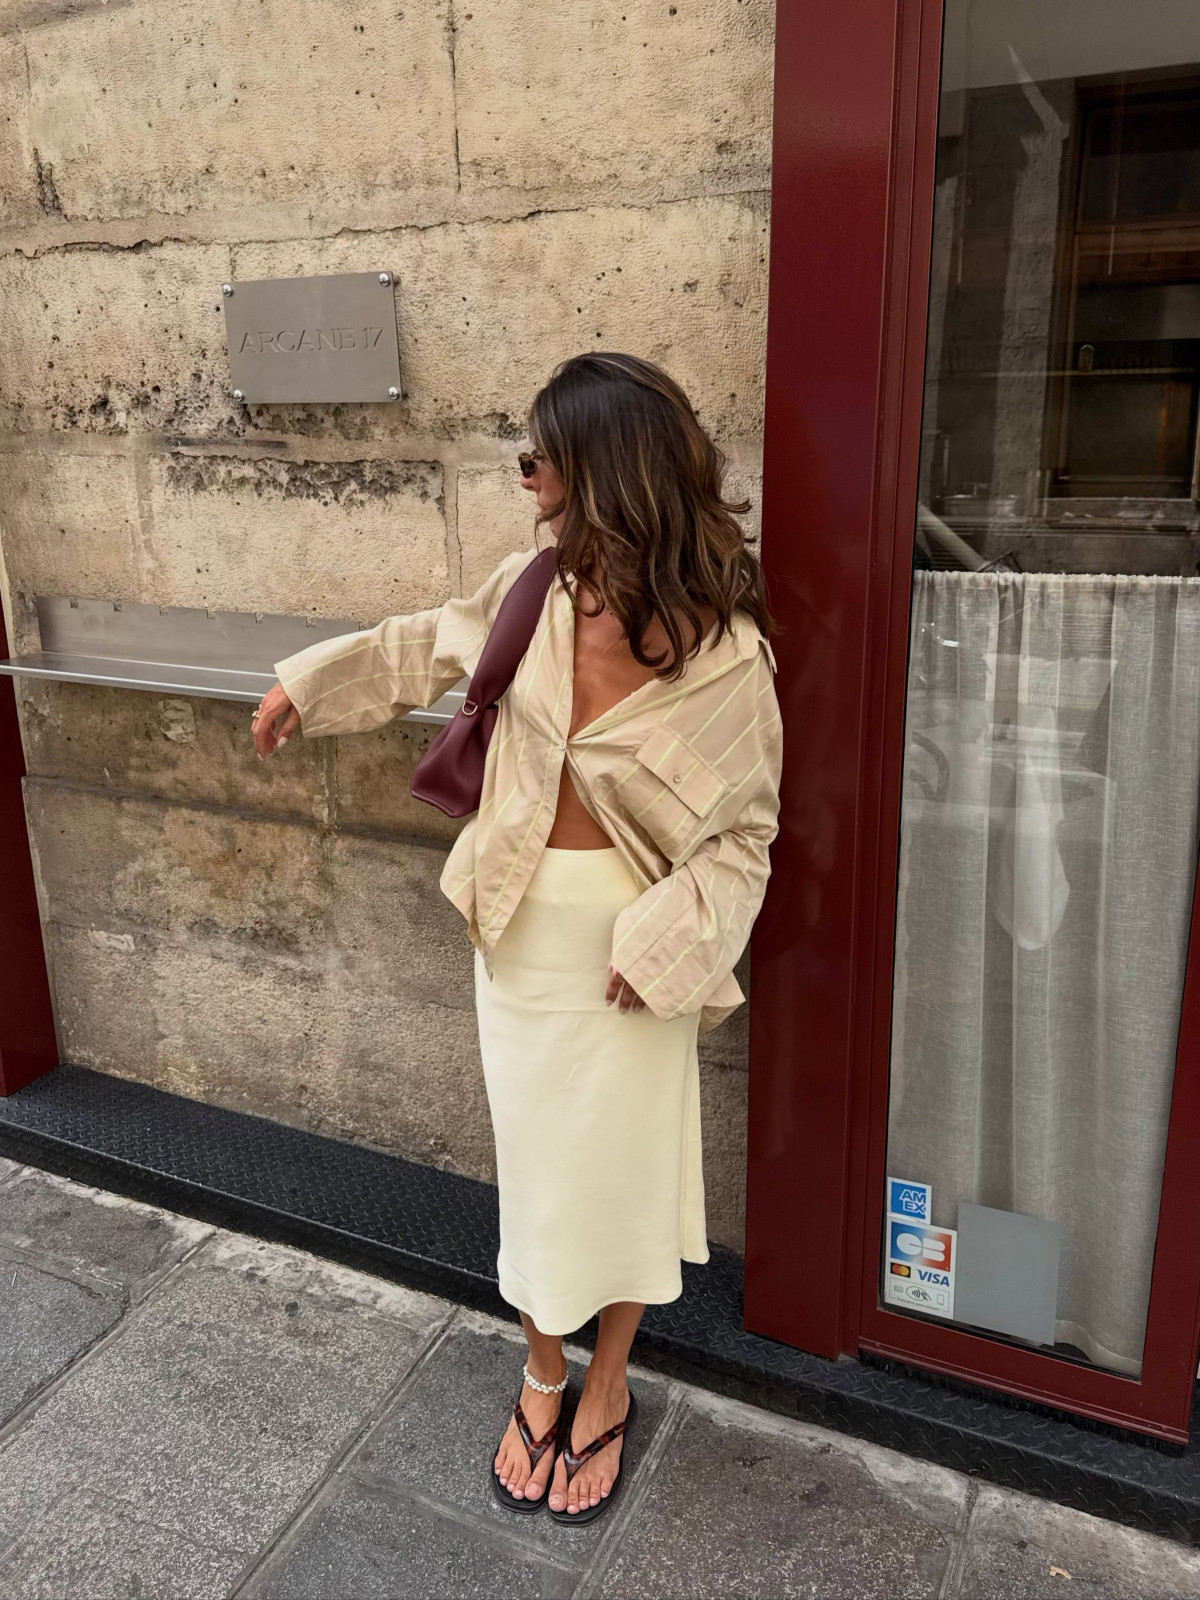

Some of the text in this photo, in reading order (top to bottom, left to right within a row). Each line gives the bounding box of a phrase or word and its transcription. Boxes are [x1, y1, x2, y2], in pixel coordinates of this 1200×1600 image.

[238, 326, 384, 354] ARCANE 17
[899, 1189, 926, 1203] AM
[903, 1200, 926, 1215] EX
[916, 1268, 950, 1287] VISA
